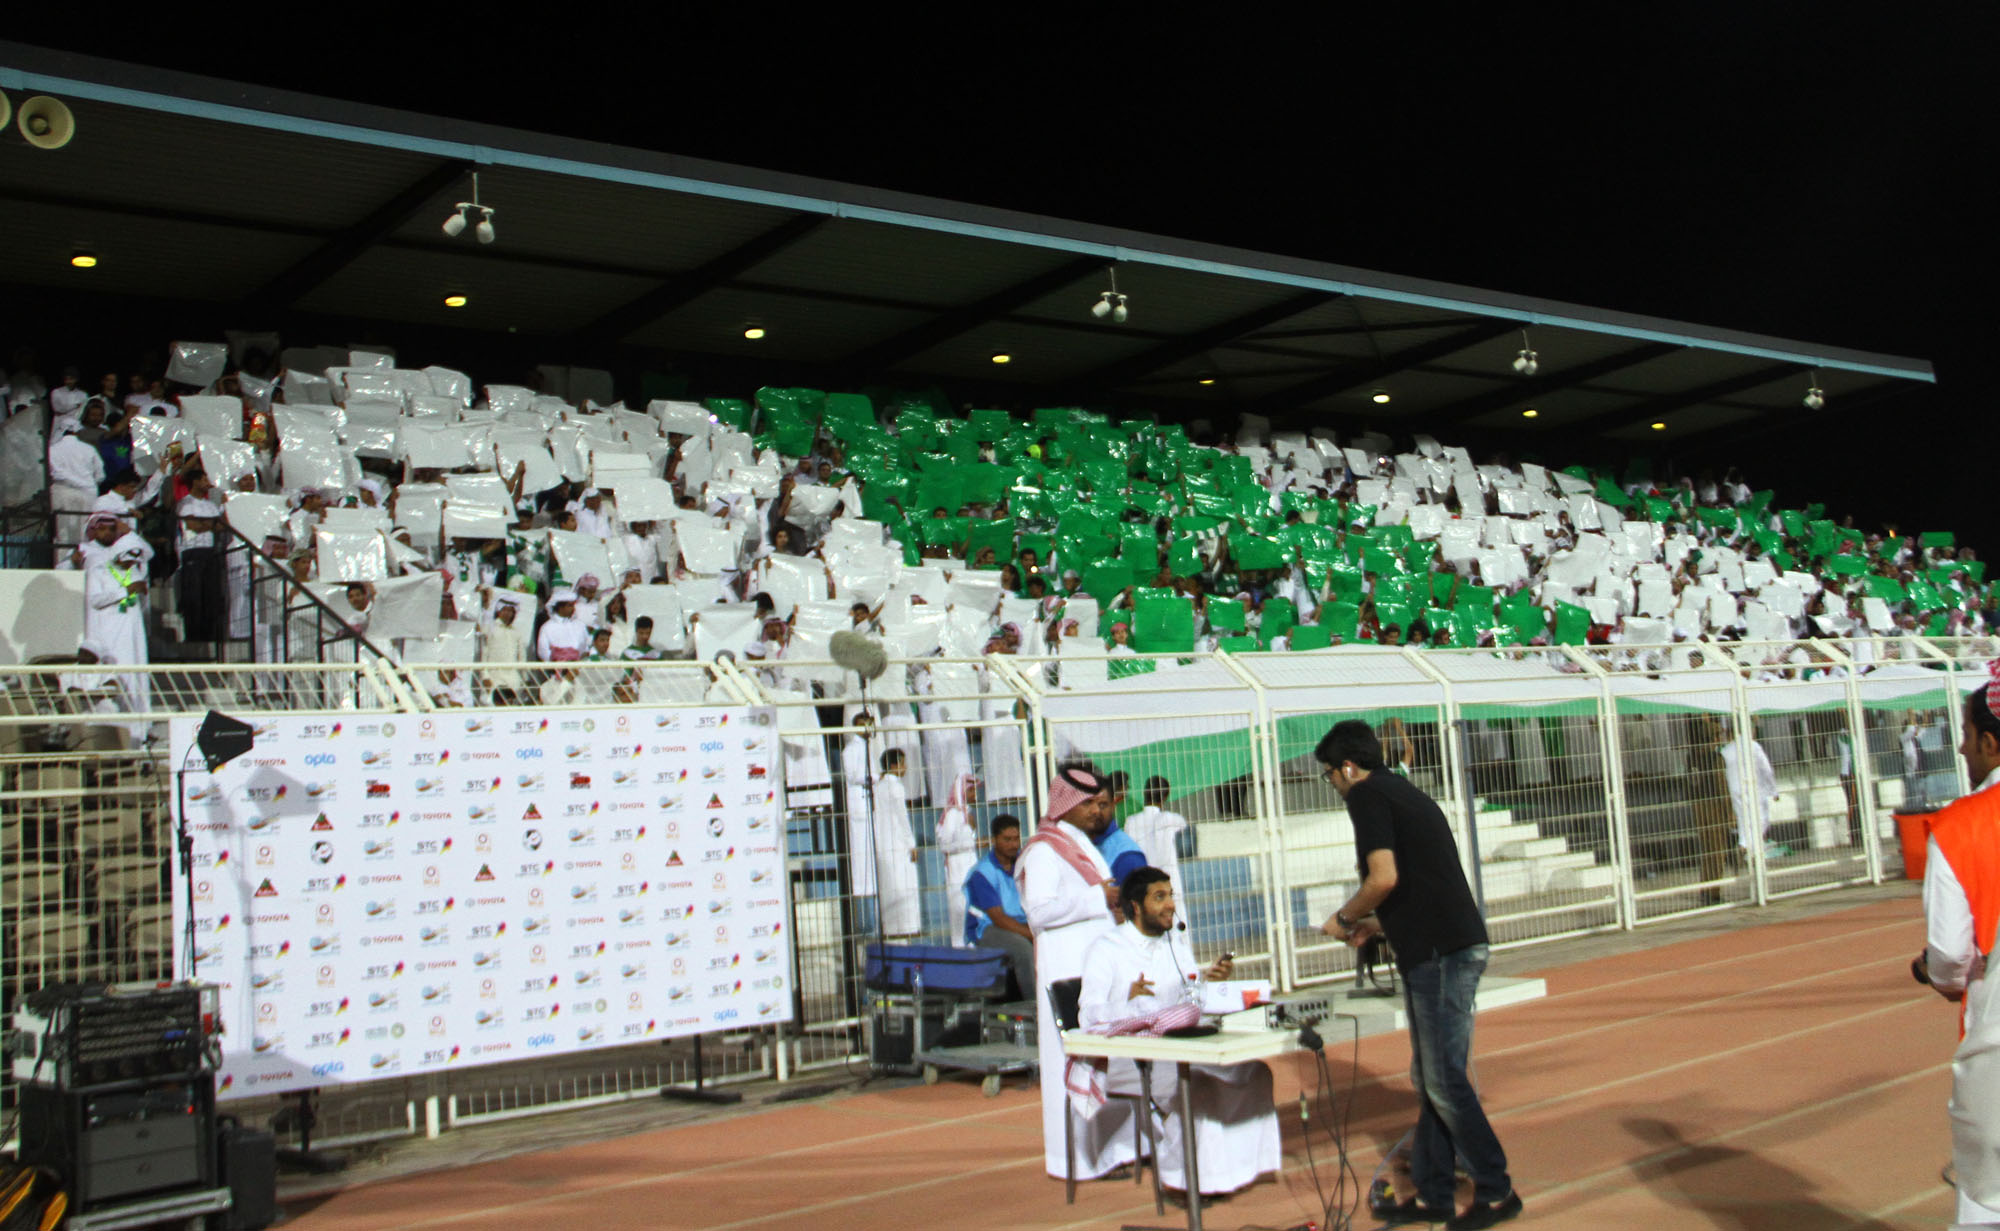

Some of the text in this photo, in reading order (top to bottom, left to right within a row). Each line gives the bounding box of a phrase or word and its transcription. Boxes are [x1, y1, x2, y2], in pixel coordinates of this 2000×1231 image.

[304, 726, 326, 734] STC
[700, 741, 723, 751] opta
[516, 748, 543, 759] opta
[611, 747, 628, 755] STC
[305, 753, 336, 766] opta
[363, 815, 384, 823] STC
[417, 841, 437, 849] STC
[618, 886, 634, 894] STC
[257, 914, 290, 922] TOYOTA
[714, 1009, 738, 1020] opta
[528, 1034, 555, 1045] opta
[483, 1043, 511, 1051] TOYOTA
[312, 1063, 344, 1075] opta
